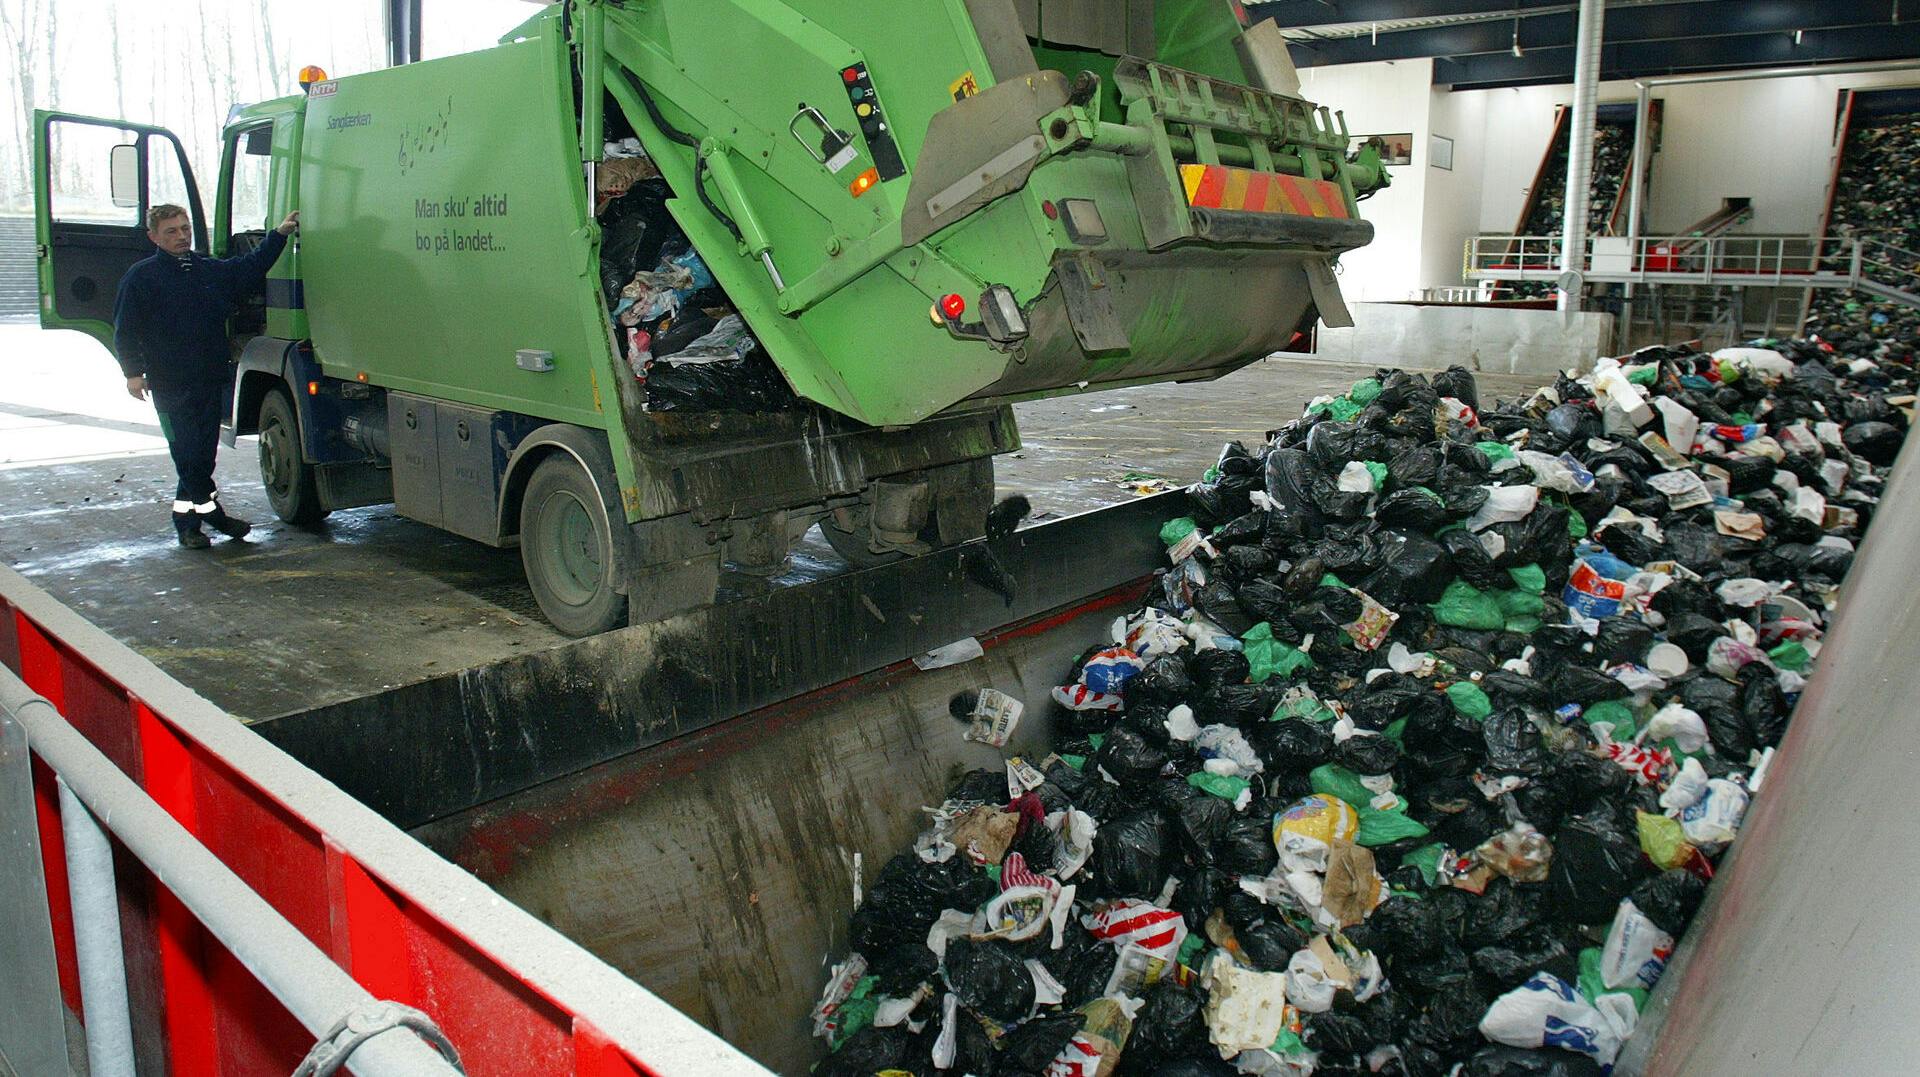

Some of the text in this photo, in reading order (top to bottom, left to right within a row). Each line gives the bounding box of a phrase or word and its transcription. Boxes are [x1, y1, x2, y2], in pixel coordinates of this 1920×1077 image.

[311, 82, 337, 97] NTM
[415, 198, 440, 218] Man
[473, 193, 507, 217] altid
[415, 228, 506, 256] bo på landet...
